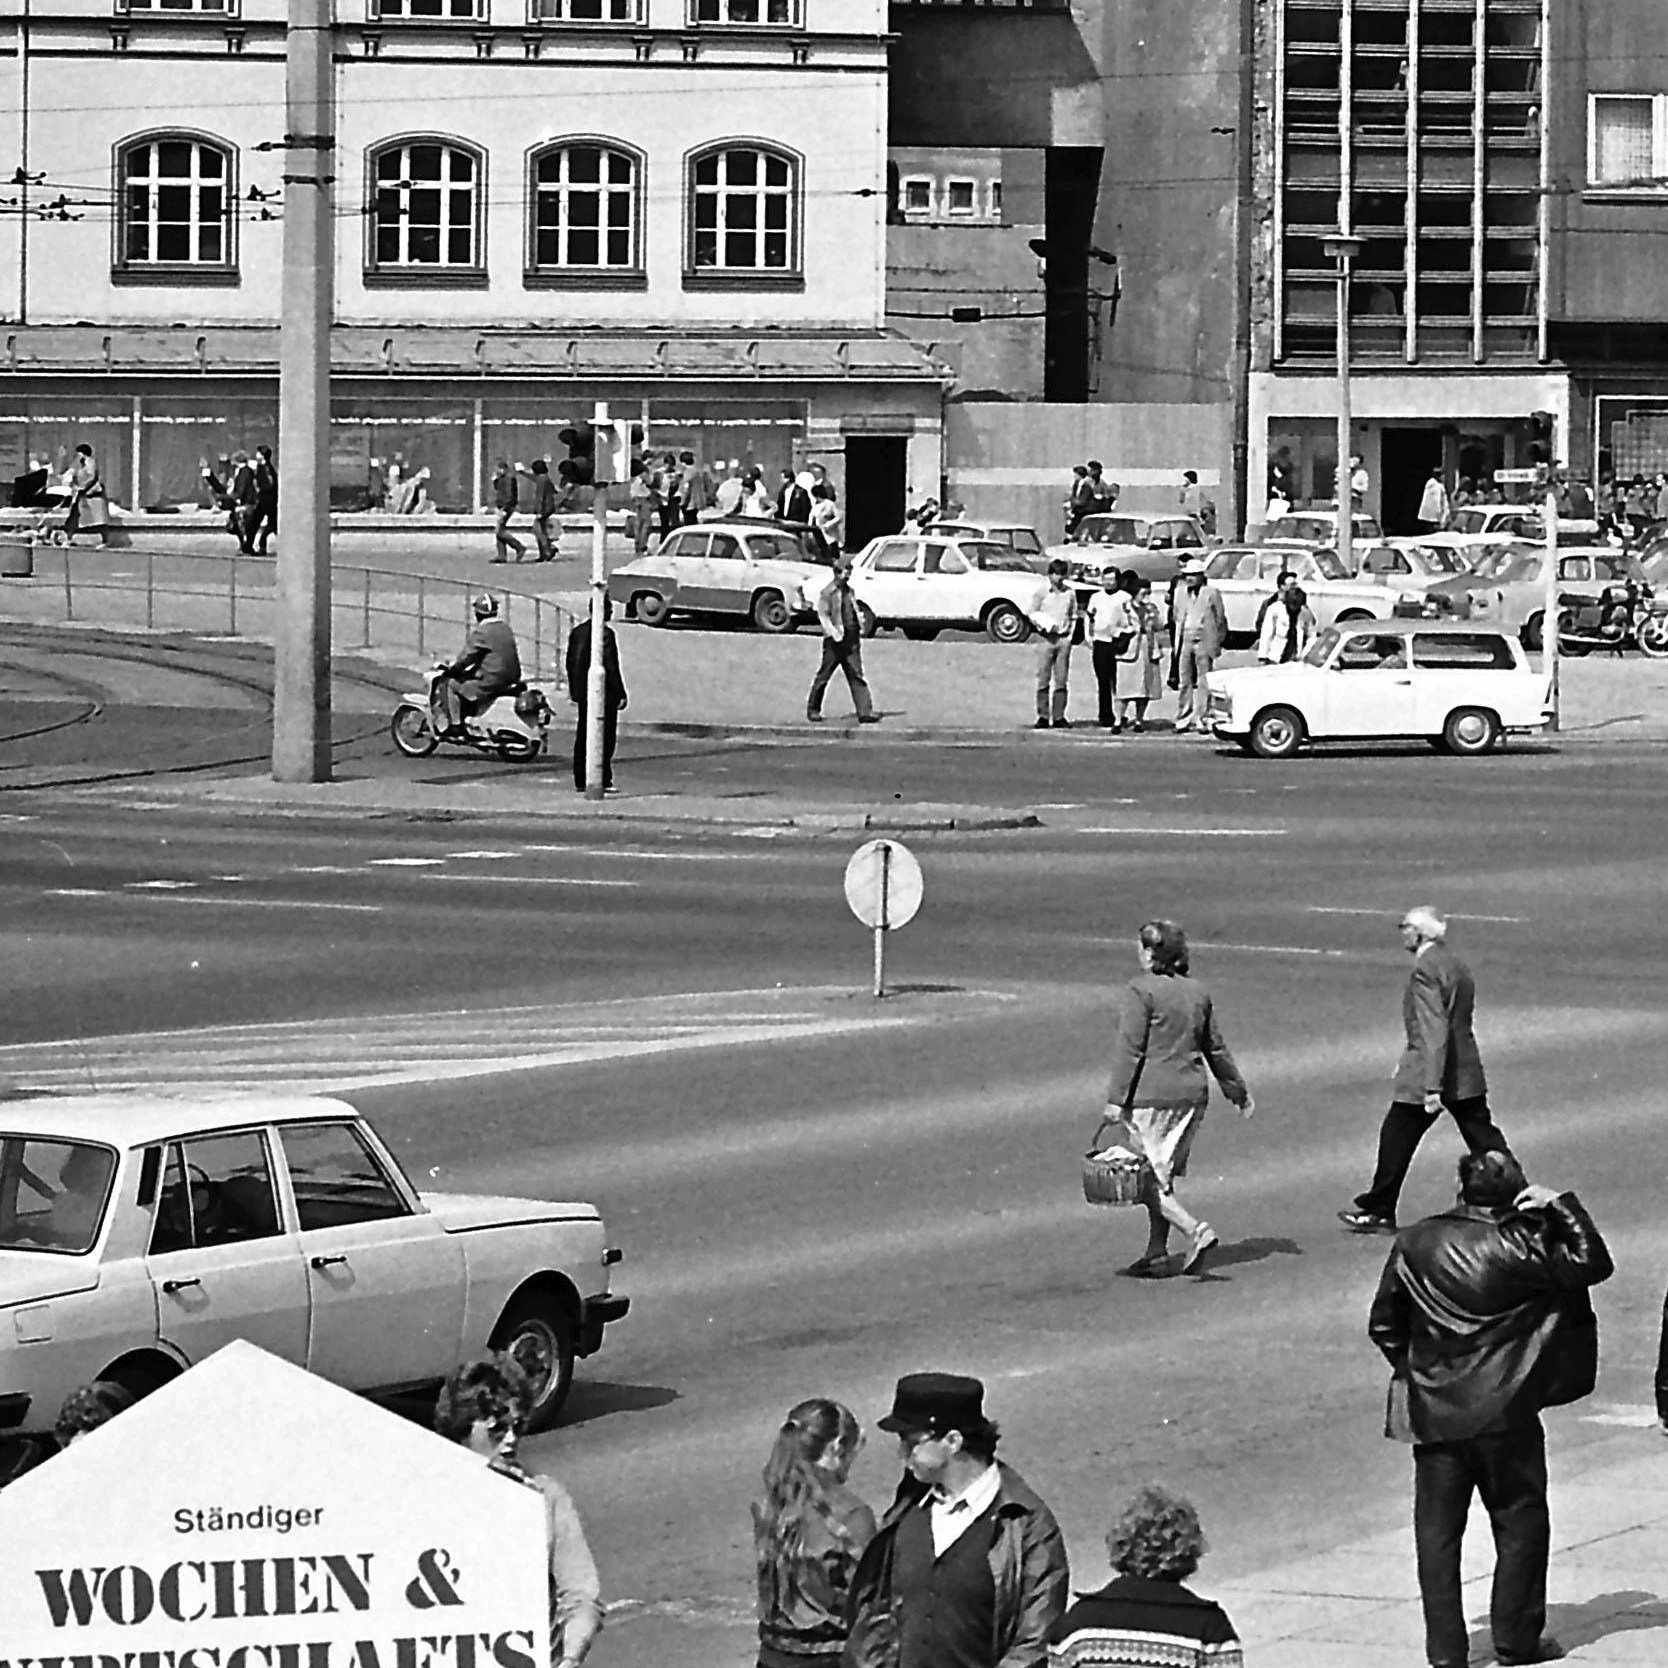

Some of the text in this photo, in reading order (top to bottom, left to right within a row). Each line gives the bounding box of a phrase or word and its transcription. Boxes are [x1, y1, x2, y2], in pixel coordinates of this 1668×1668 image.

[174, 1504, 324, 1534] Ständiger
[34, 1548, 465, 1628] WOCHEN &
